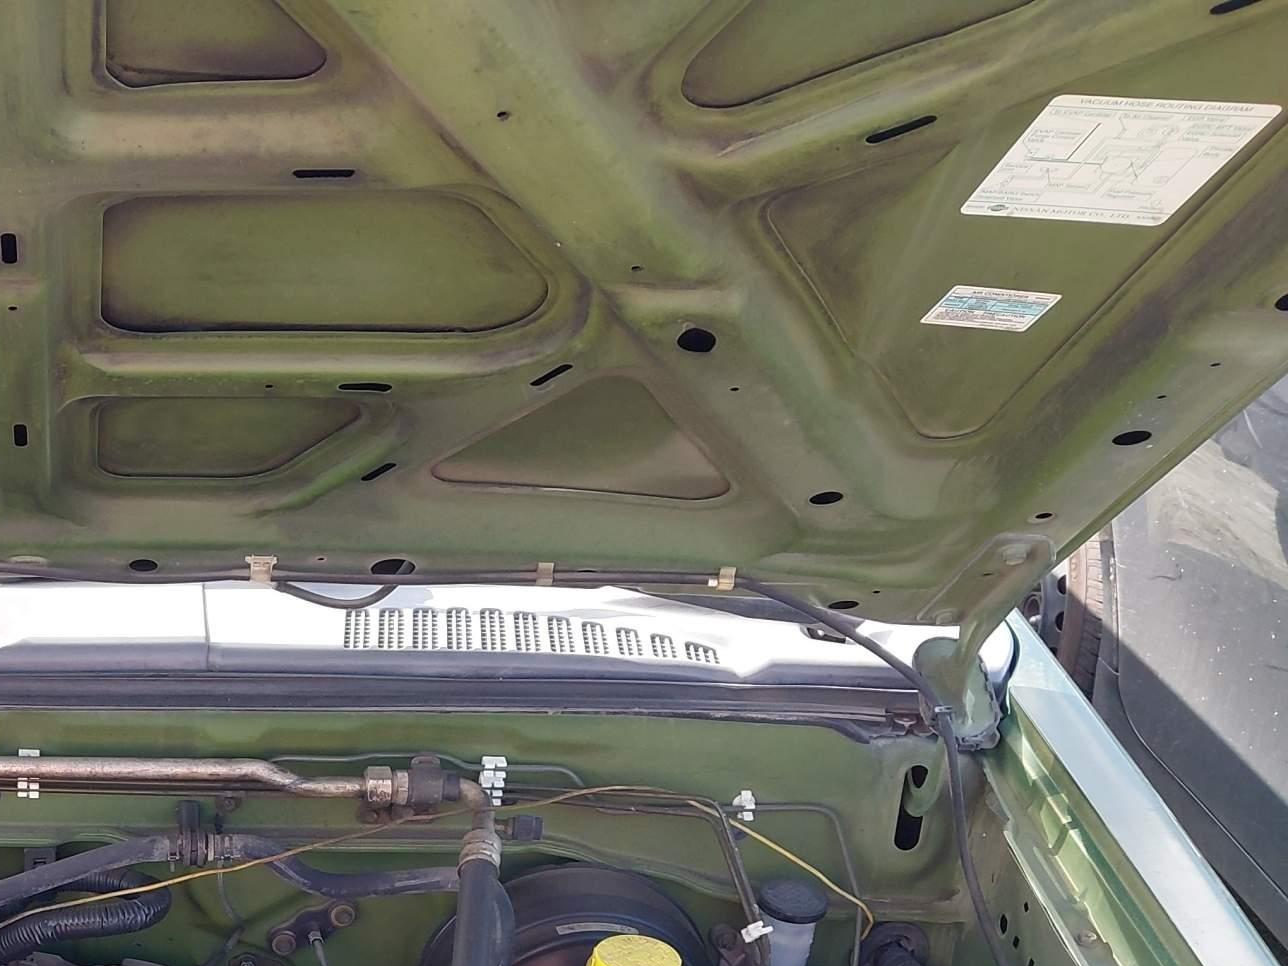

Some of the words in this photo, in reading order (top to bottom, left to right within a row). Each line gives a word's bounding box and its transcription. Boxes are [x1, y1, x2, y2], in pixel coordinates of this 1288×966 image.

[1079, 98, 1124, 106] VACUUM
[1155, 102, 1203, 110] ROUTING
[1202, 104, 1254, 112] DIAGRAM
